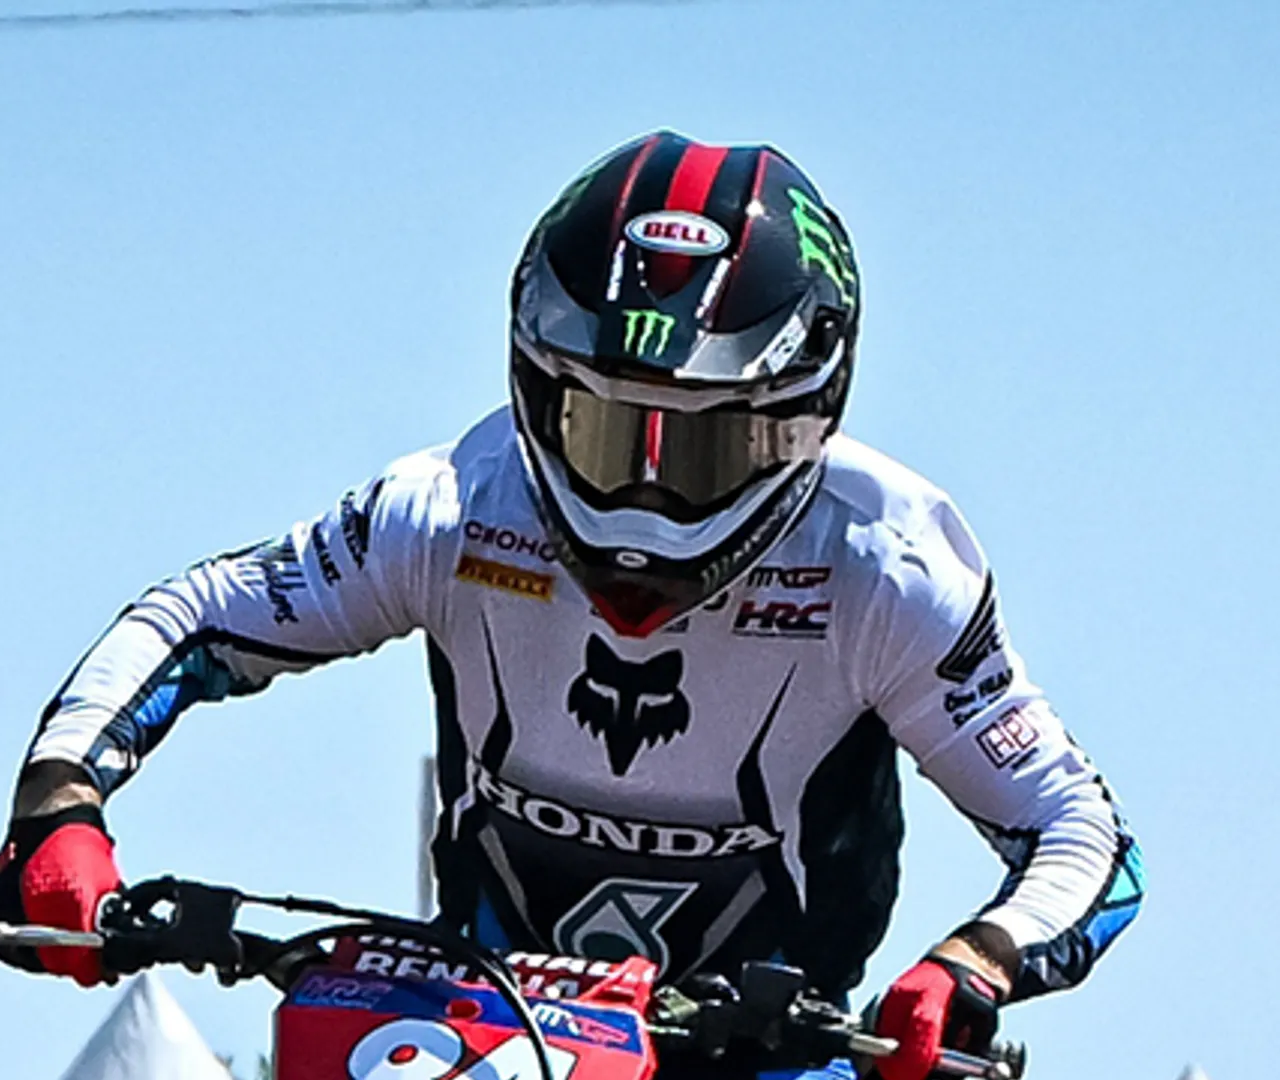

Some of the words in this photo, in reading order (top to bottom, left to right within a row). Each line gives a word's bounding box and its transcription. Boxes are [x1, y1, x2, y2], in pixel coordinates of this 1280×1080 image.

[643, 221, 710, 245] BELL
[733, 600, 833, 631] HRC
[477, 772, 780, 859] HONDA
